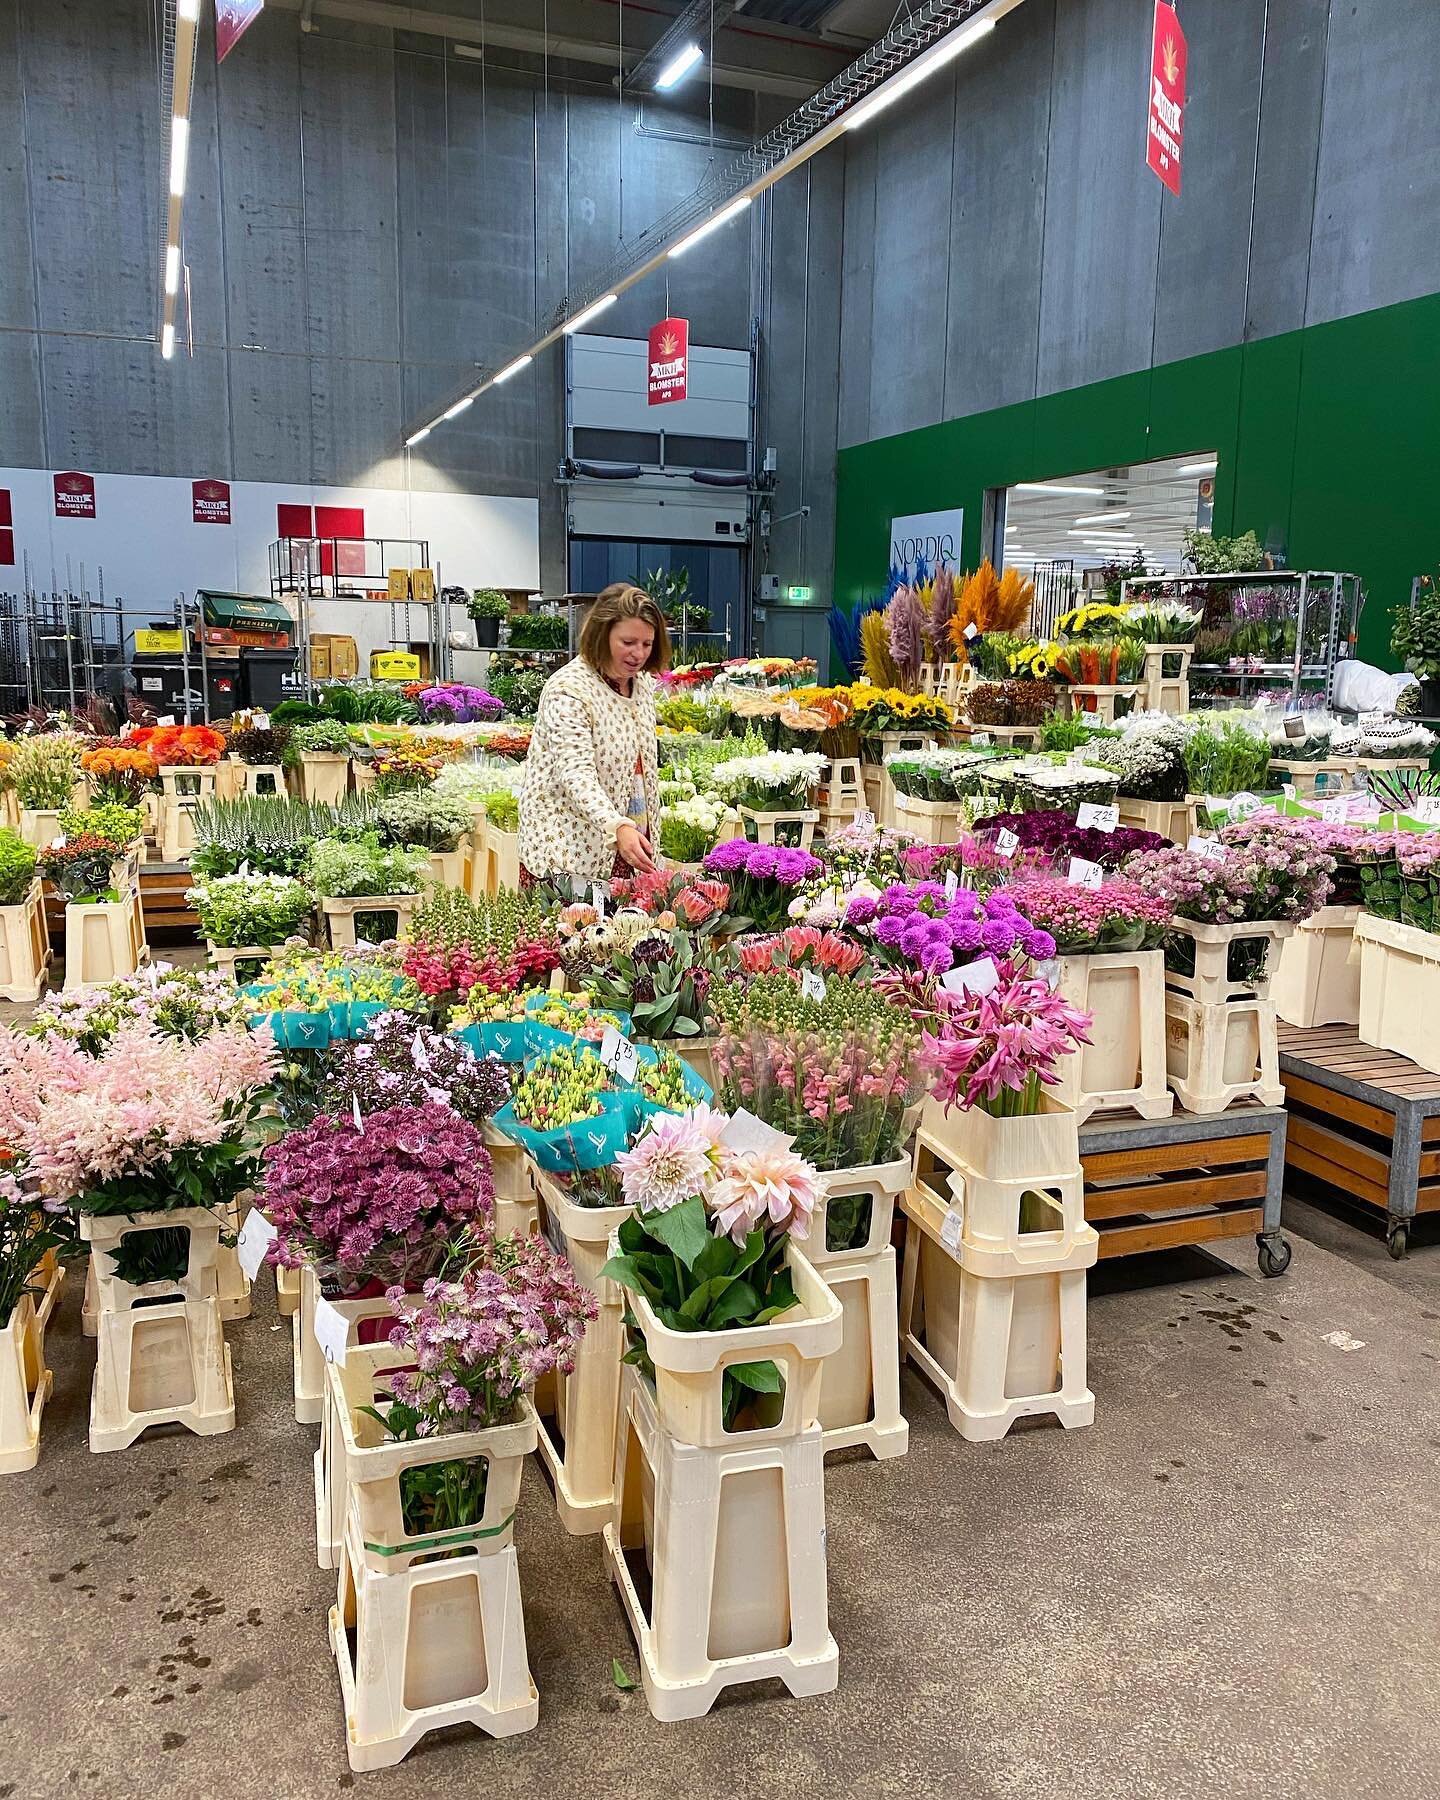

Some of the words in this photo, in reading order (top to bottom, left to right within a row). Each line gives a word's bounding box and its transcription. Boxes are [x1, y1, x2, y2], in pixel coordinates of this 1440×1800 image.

[1159, 95, 1180, 134] MKH
[1150, 115, 1181, 163] BLOMSTER
[657, 361, 678, 377] MKH
[649, 376, 685, 392] BLOMSTER
[661, 390, 672, 399] APS
[64, 494, 86, 503] MKH
[56, 502, 94, 511] BLOMSTER
[201, 501, 222, 510] MKH
[194, 509, 230, 517] BLOMSTER
[893, 534, 958, 565] NORDIQ
